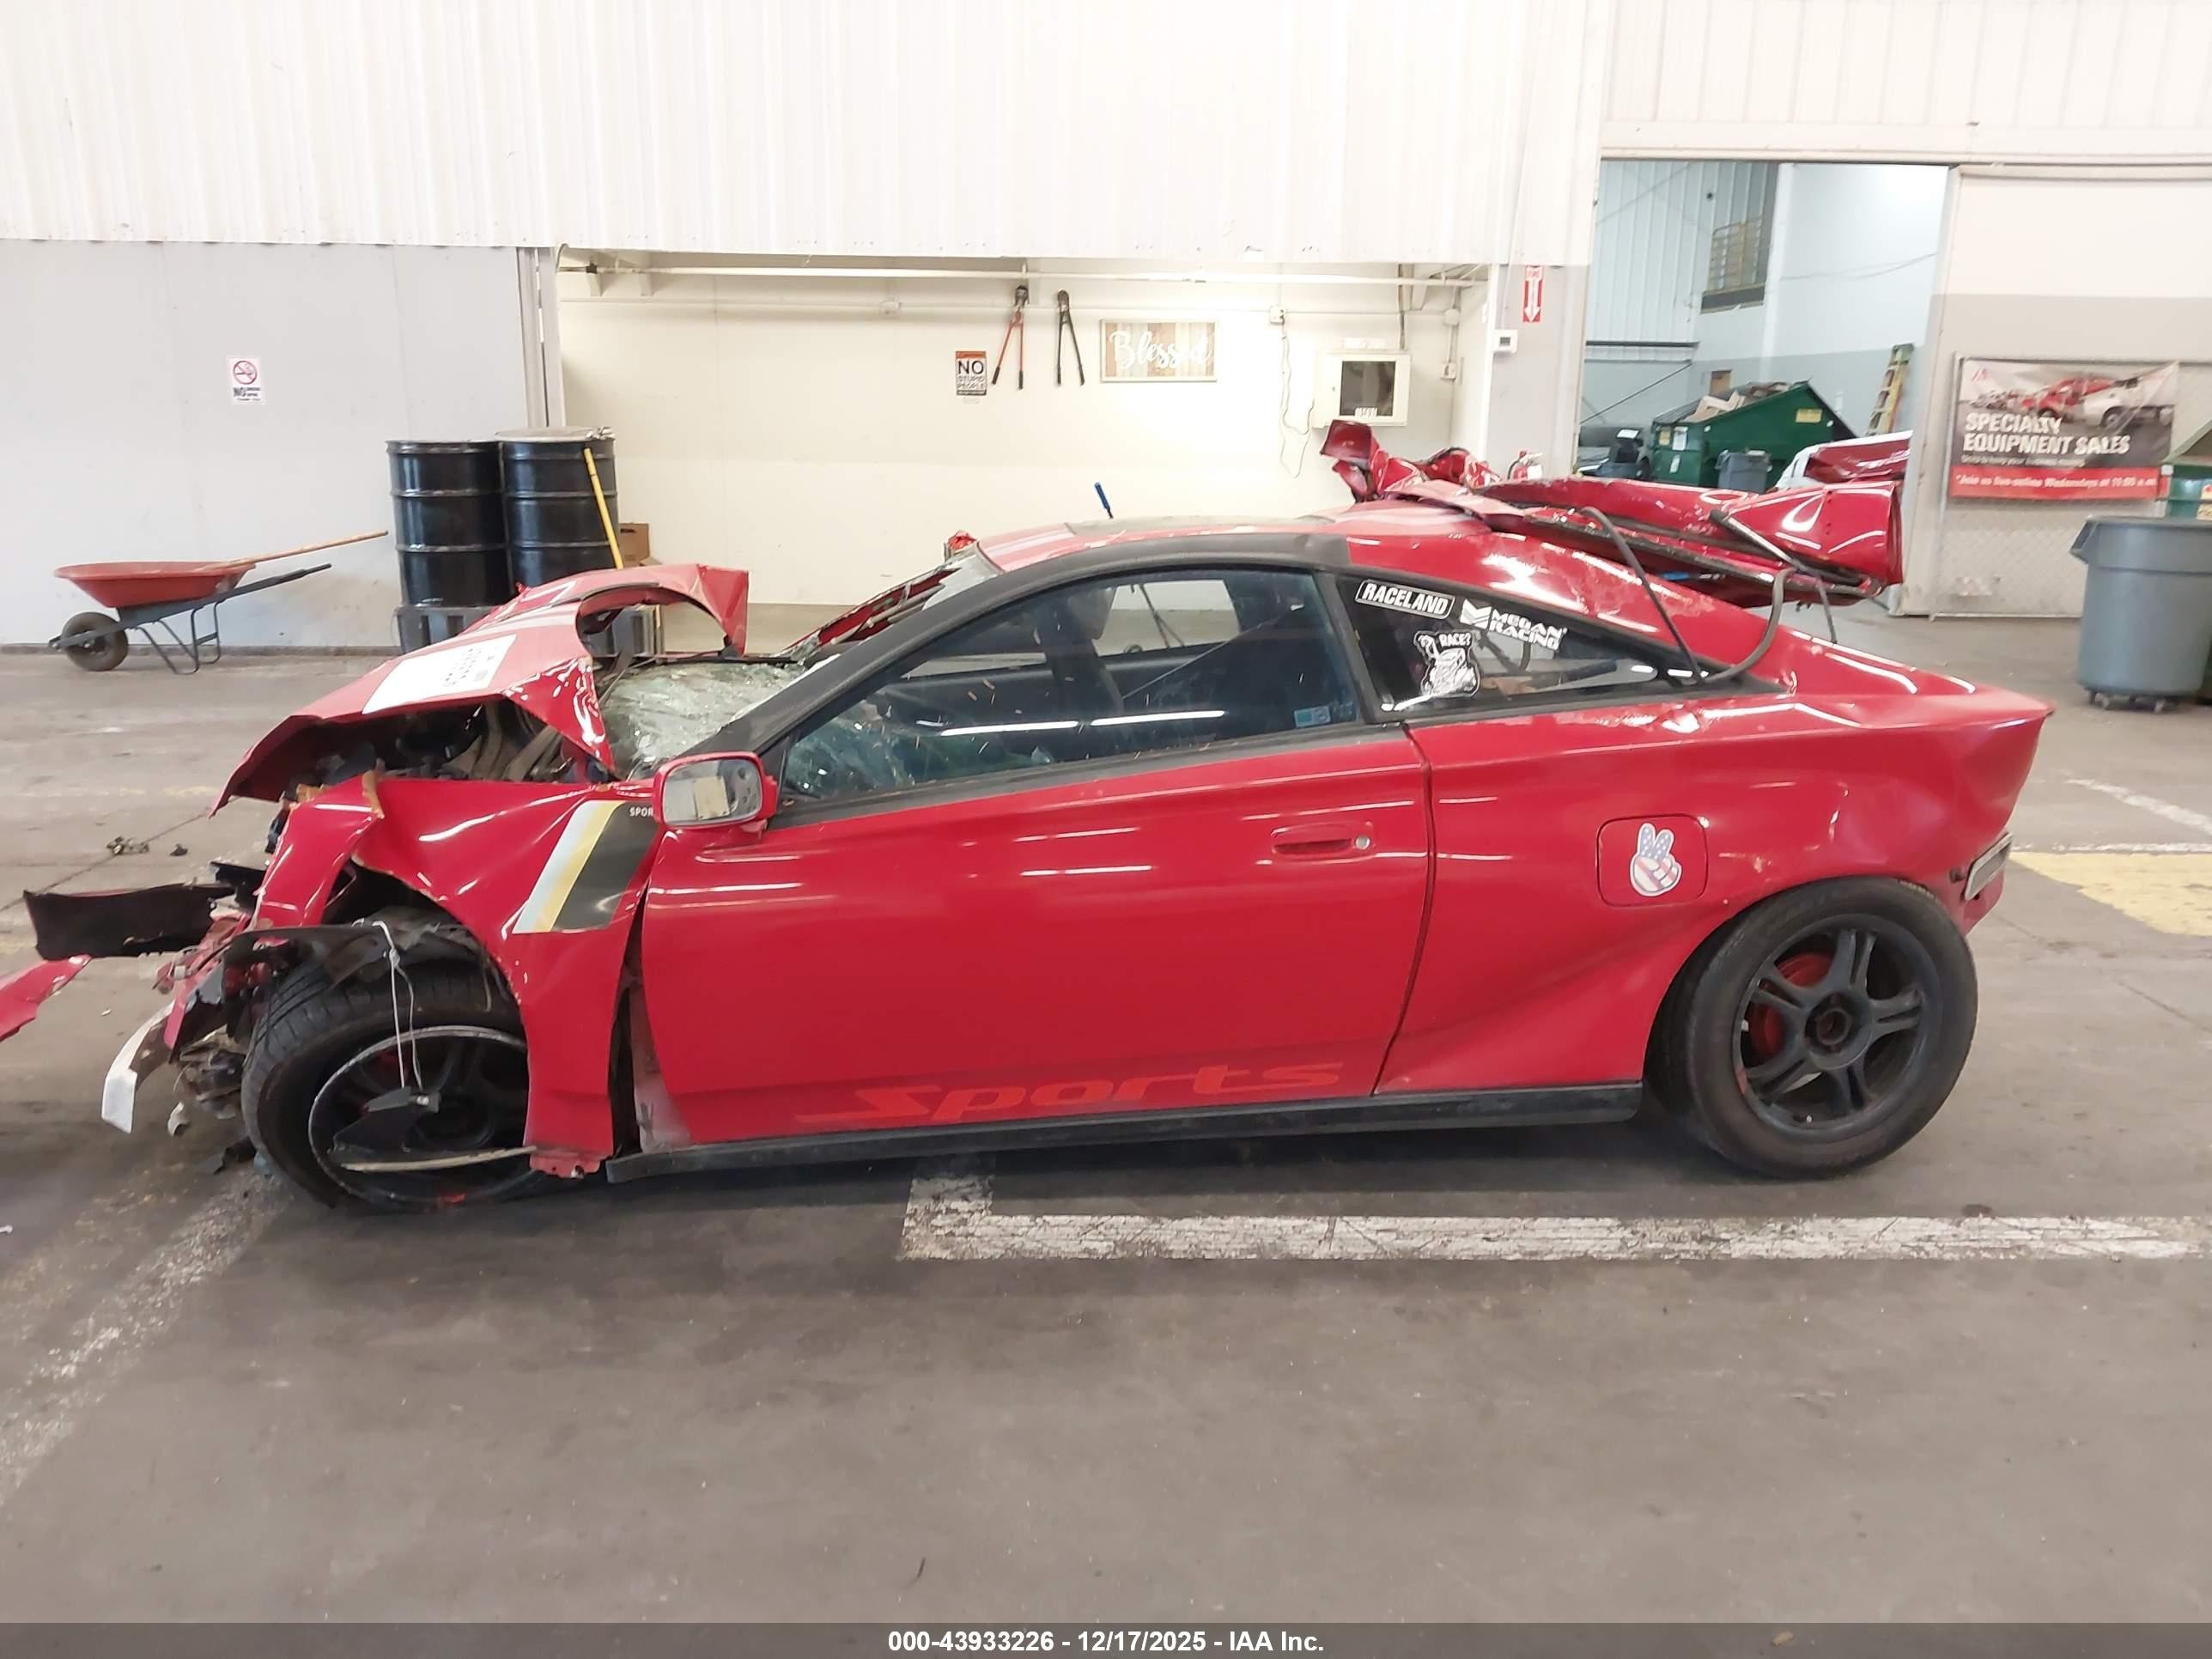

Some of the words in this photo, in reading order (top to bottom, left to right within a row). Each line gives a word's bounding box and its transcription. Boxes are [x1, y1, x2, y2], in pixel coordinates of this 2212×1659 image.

[957, 360, 984, 374] NO
[1966, 412, 2062, 434] SPECIALTY
[1963, 433, 2074, 455] EQUIPMENT
[2074, 435, 2130, 455] SALES
[1362, 582, 1449, 615] RACELAND
[1489, 620, 1562, 650] RACING
[1492, 609, 1562, 639] MEGAN
